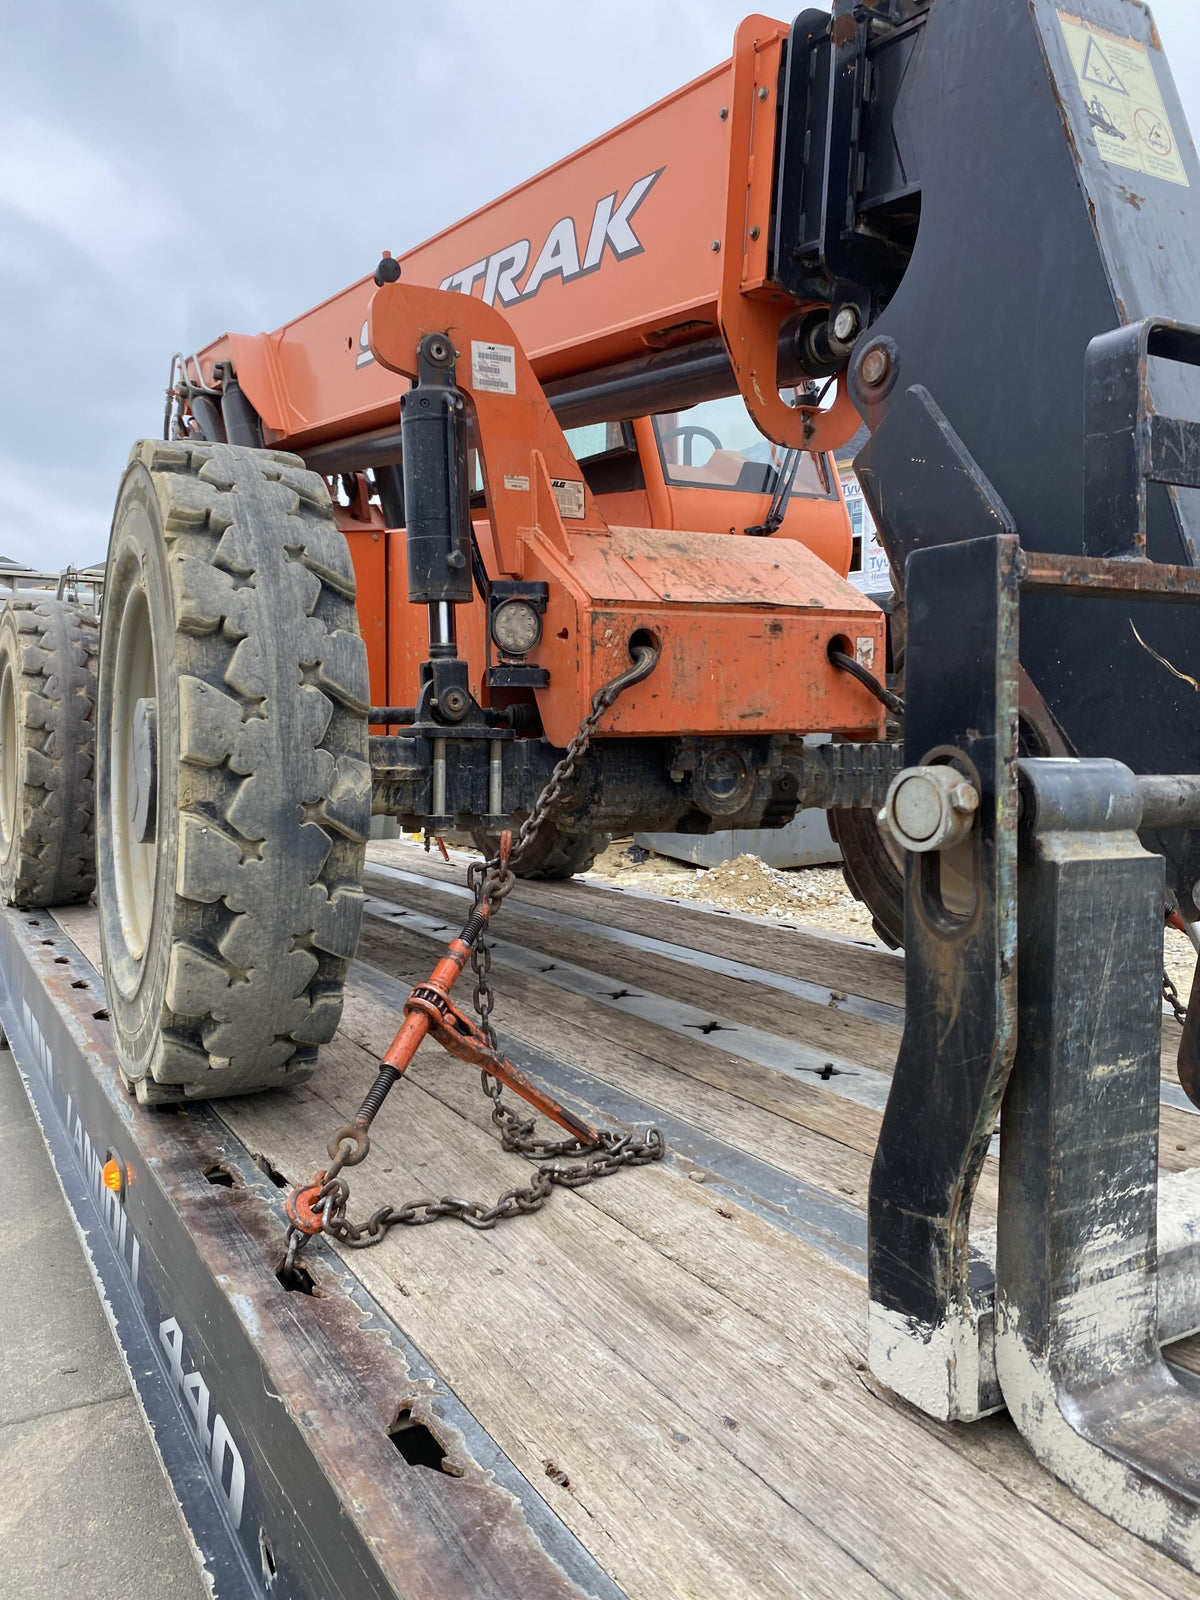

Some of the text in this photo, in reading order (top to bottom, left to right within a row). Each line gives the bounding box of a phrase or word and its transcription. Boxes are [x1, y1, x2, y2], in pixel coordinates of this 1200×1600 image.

[842, 484, 861, 496] Tyv
[870, 557, 888, 571] Tyv
[159, 1316, 245, 1529] 440
